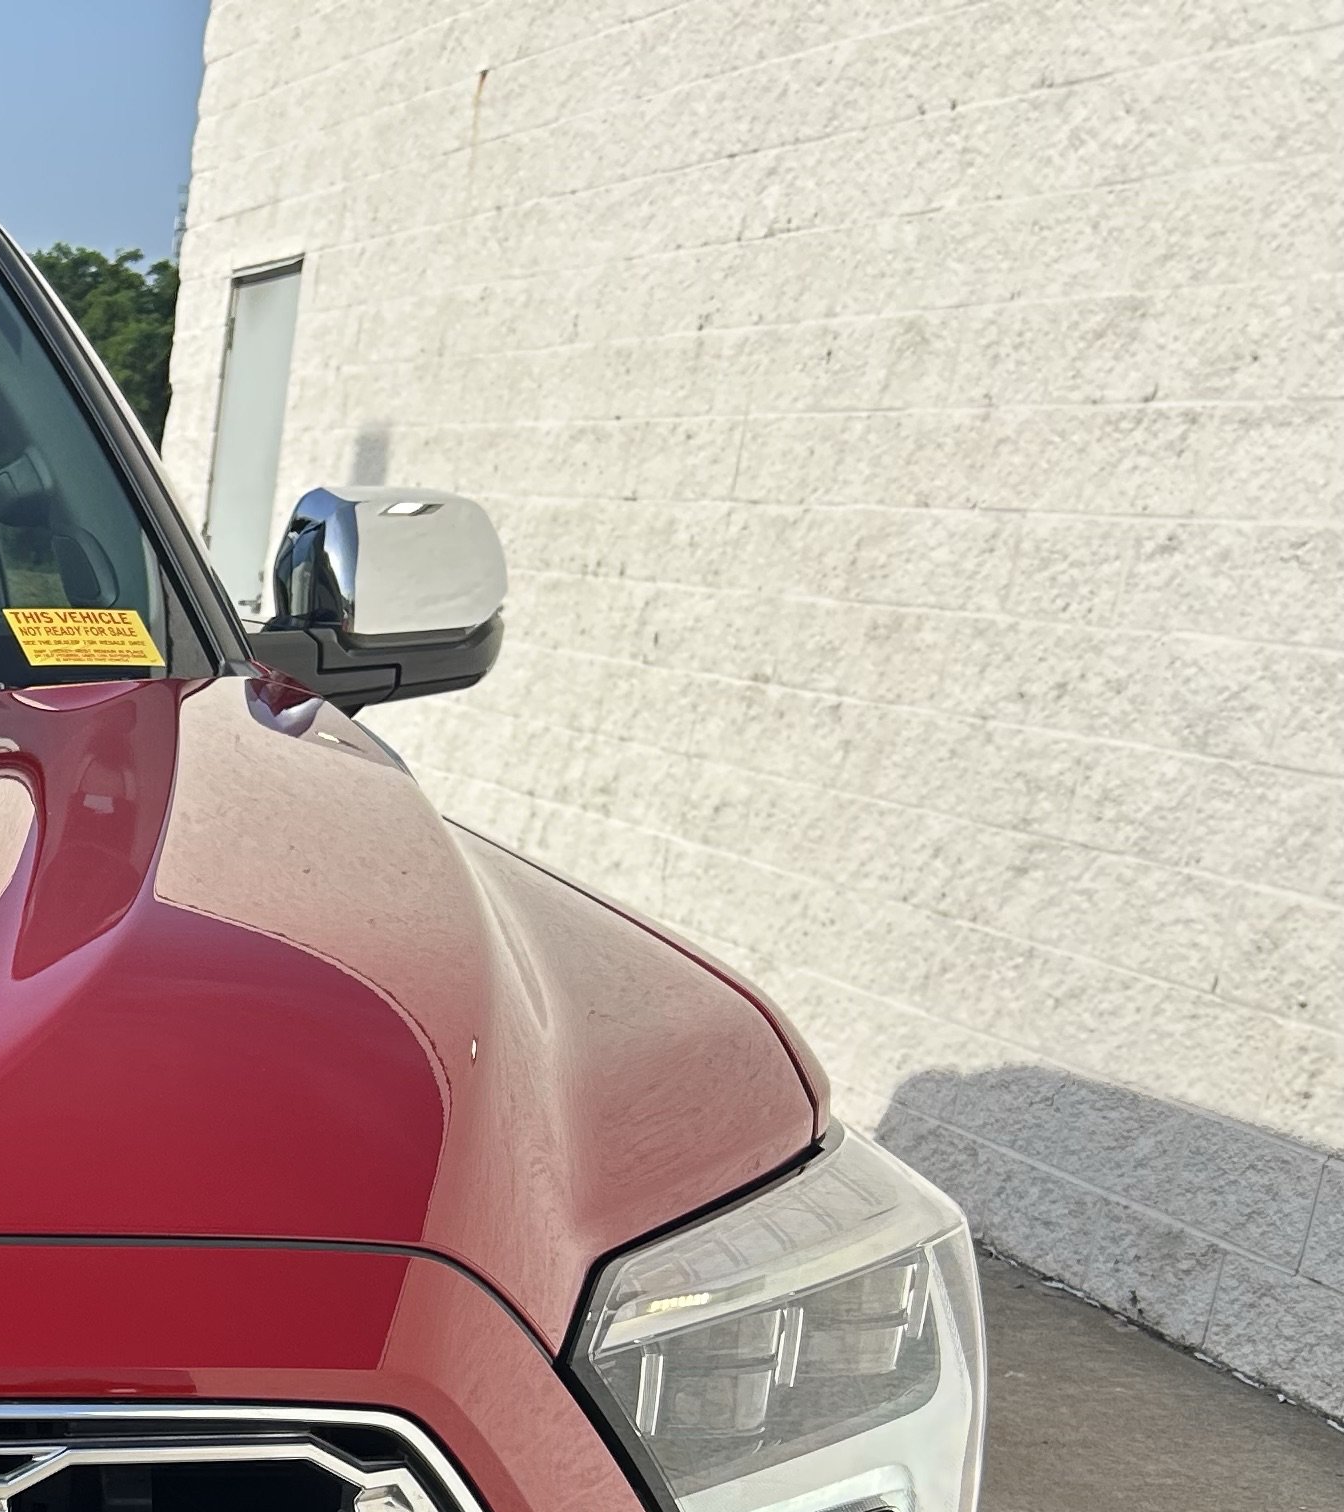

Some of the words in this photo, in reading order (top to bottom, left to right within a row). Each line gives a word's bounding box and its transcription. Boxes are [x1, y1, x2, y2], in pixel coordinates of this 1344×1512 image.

[10, 611, 54, 624] THIS
[54, 611, 132, 625] VEHICLE
[18, 626, 42, 637] NOT
[43, 626, 82, 637] READY
[83, 626, 108, 637] FOR
[108, 627, 138, 638] SALE
